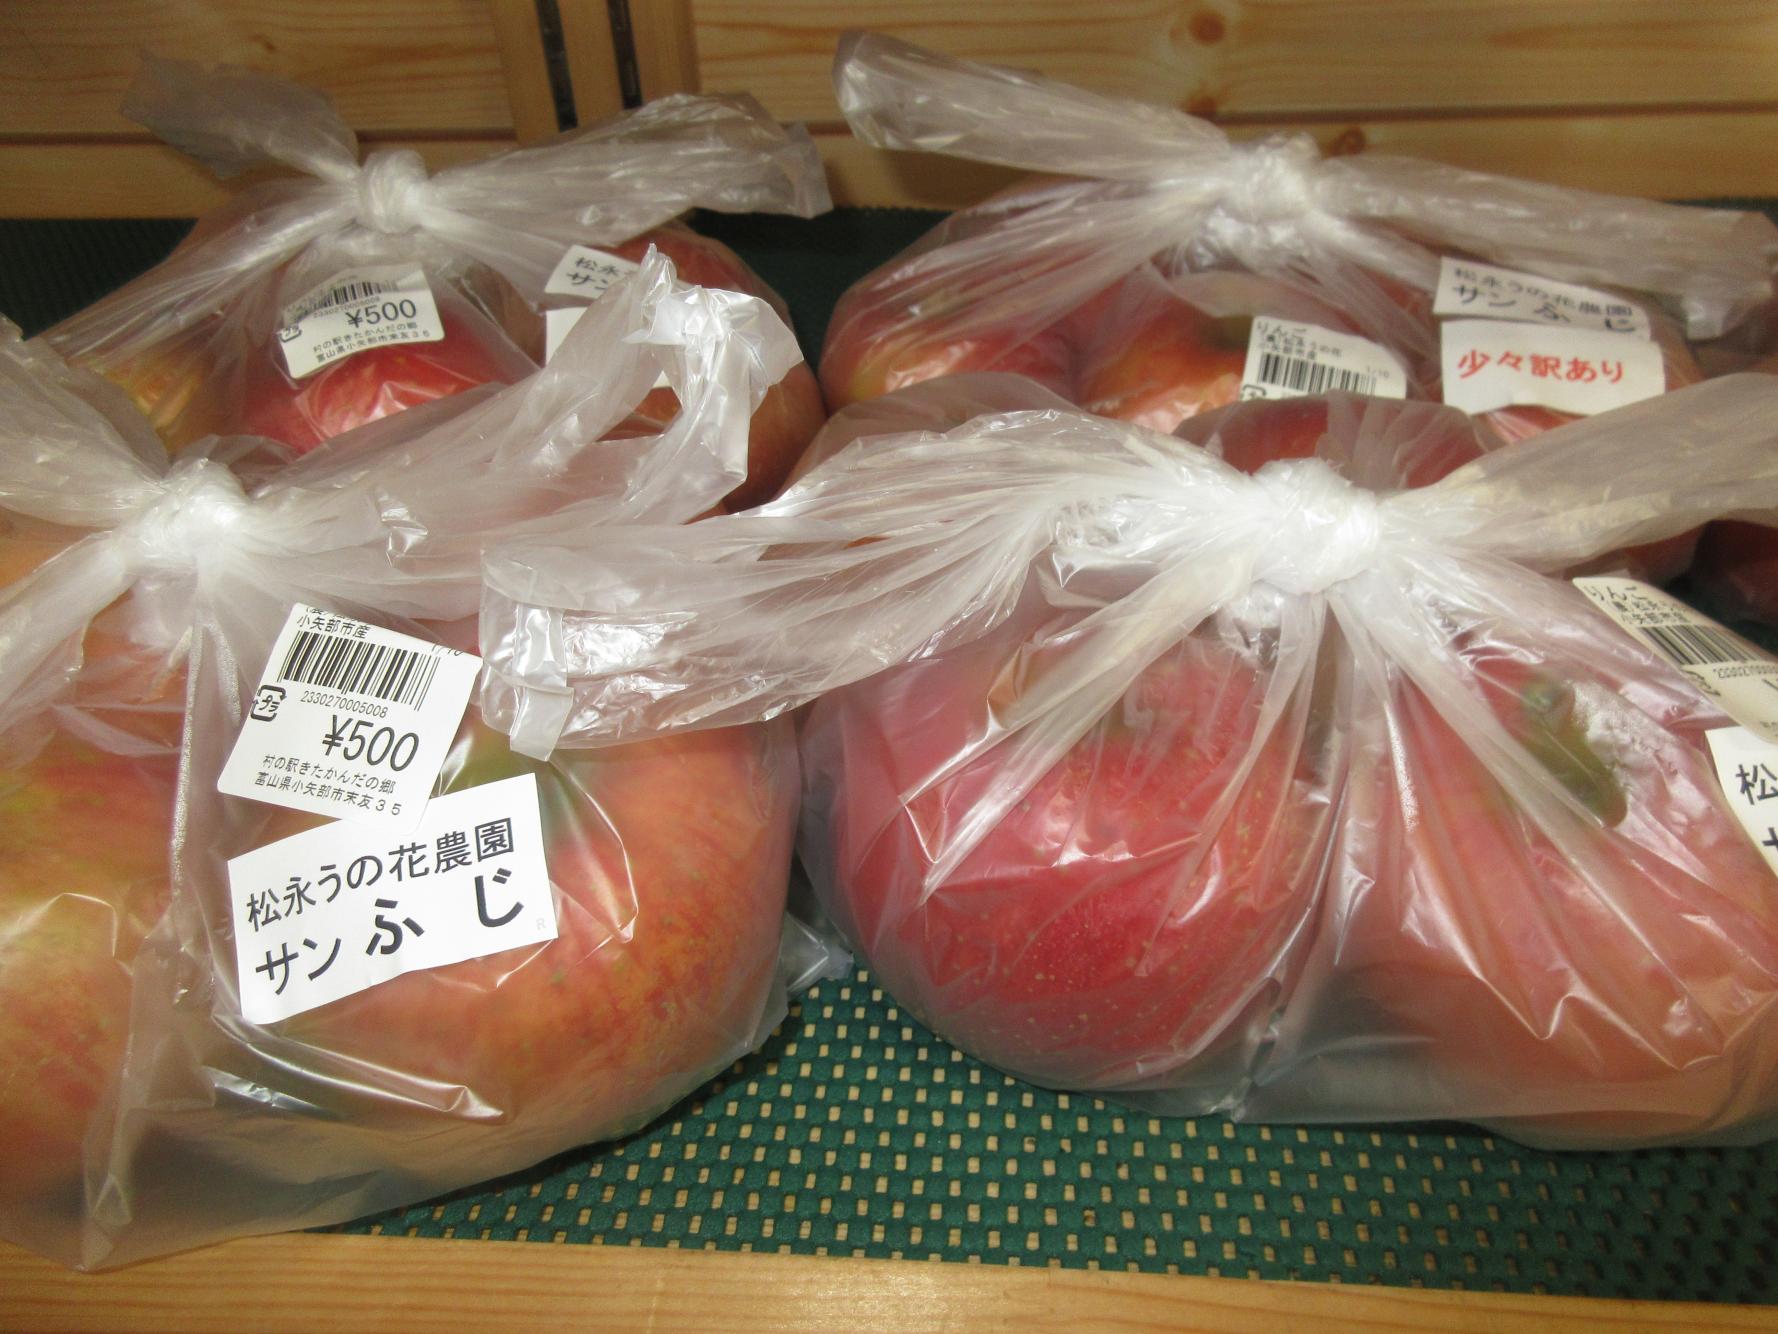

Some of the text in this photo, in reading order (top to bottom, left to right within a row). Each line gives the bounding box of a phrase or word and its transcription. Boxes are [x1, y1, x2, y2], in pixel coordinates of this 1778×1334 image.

[345, 299, 417, 328] ¥500
[1457, 350, 1624, 384] 少々訳あり
[297, 614, 371, 639] 小矢部市産
[300, 690, 388, 718] 2330270005008
[322, 715, 419, 772] ¥500
[263, 754, 396, 794] 村の駅きたかんだの郷
[247, 817, 514, 932] 松永うの花農園
